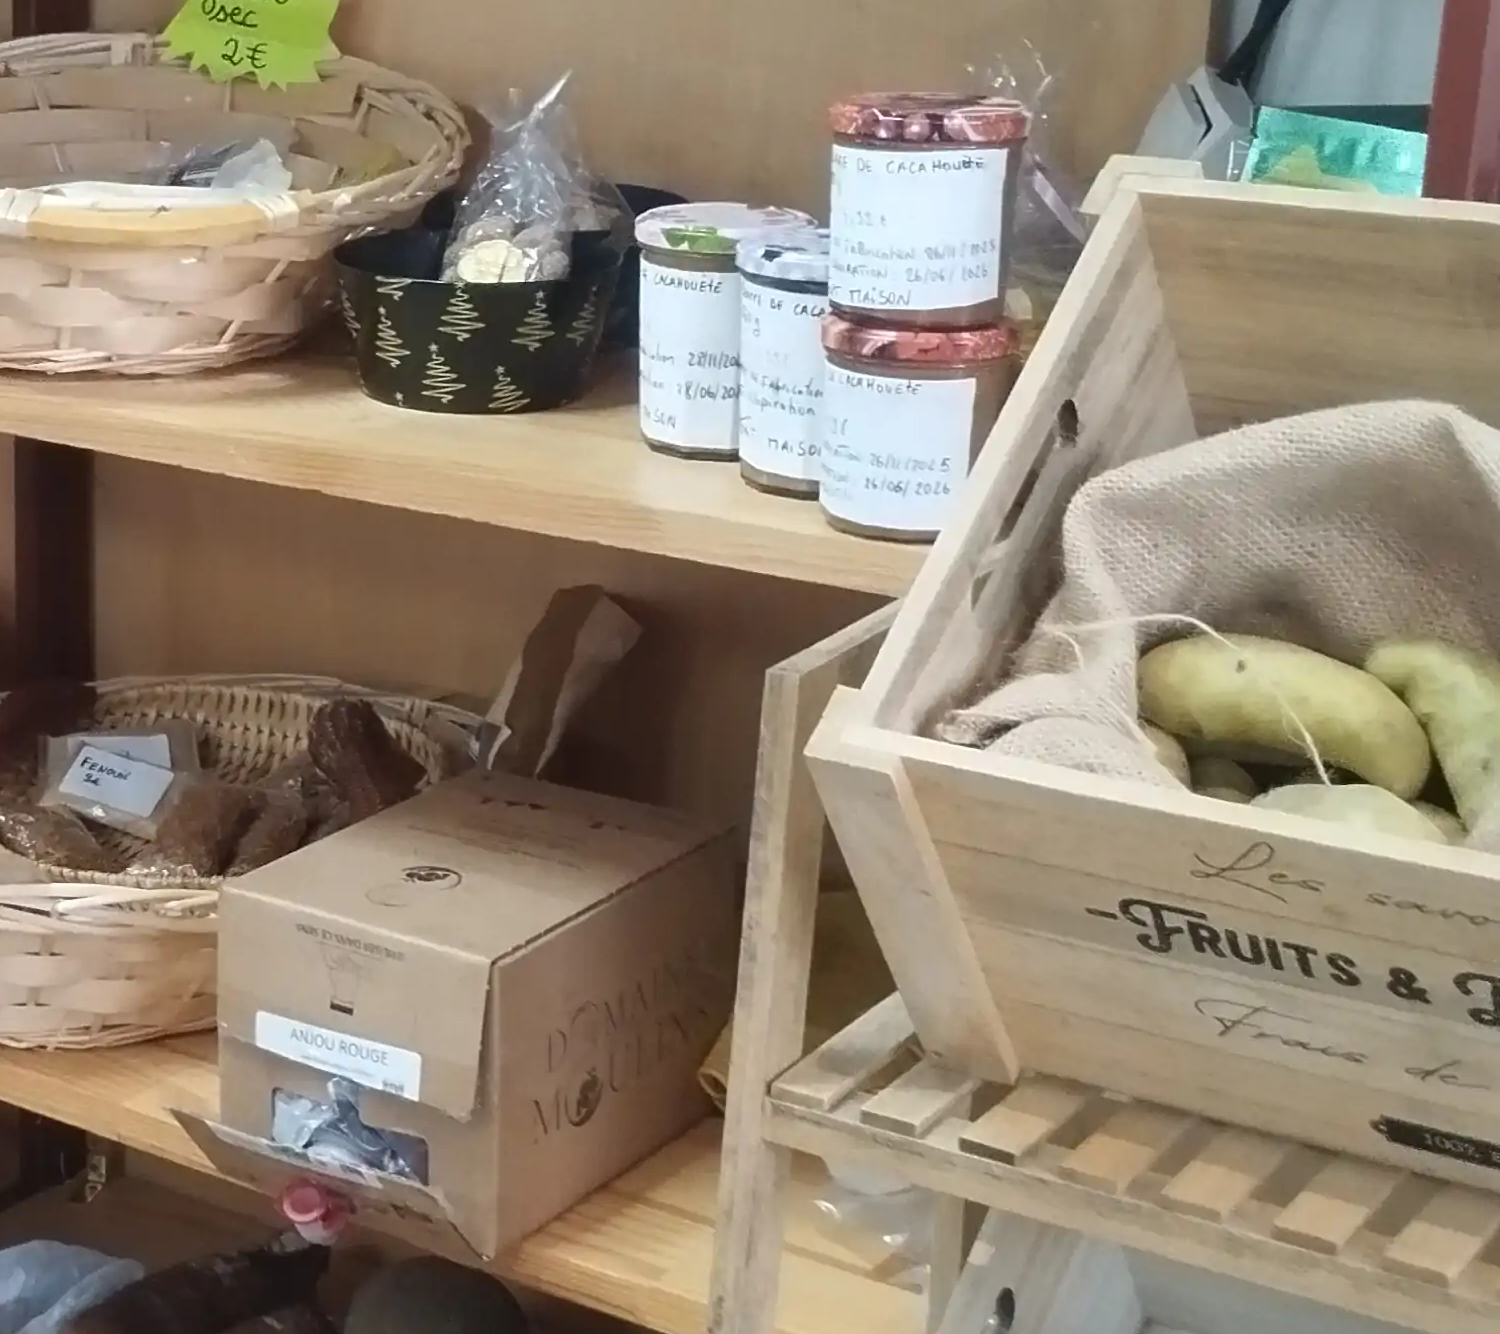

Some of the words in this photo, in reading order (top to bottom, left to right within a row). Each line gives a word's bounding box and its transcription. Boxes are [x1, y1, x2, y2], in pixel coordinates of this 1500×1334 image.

[208, 5, 258, 28] sec
[1365, 890, 1500, 928] savo
[1385, 966, 1433, 1006] &
[289, 1027, 336, 1052] ANJOU
[338, 1038, 390, 1067] ROUGE
